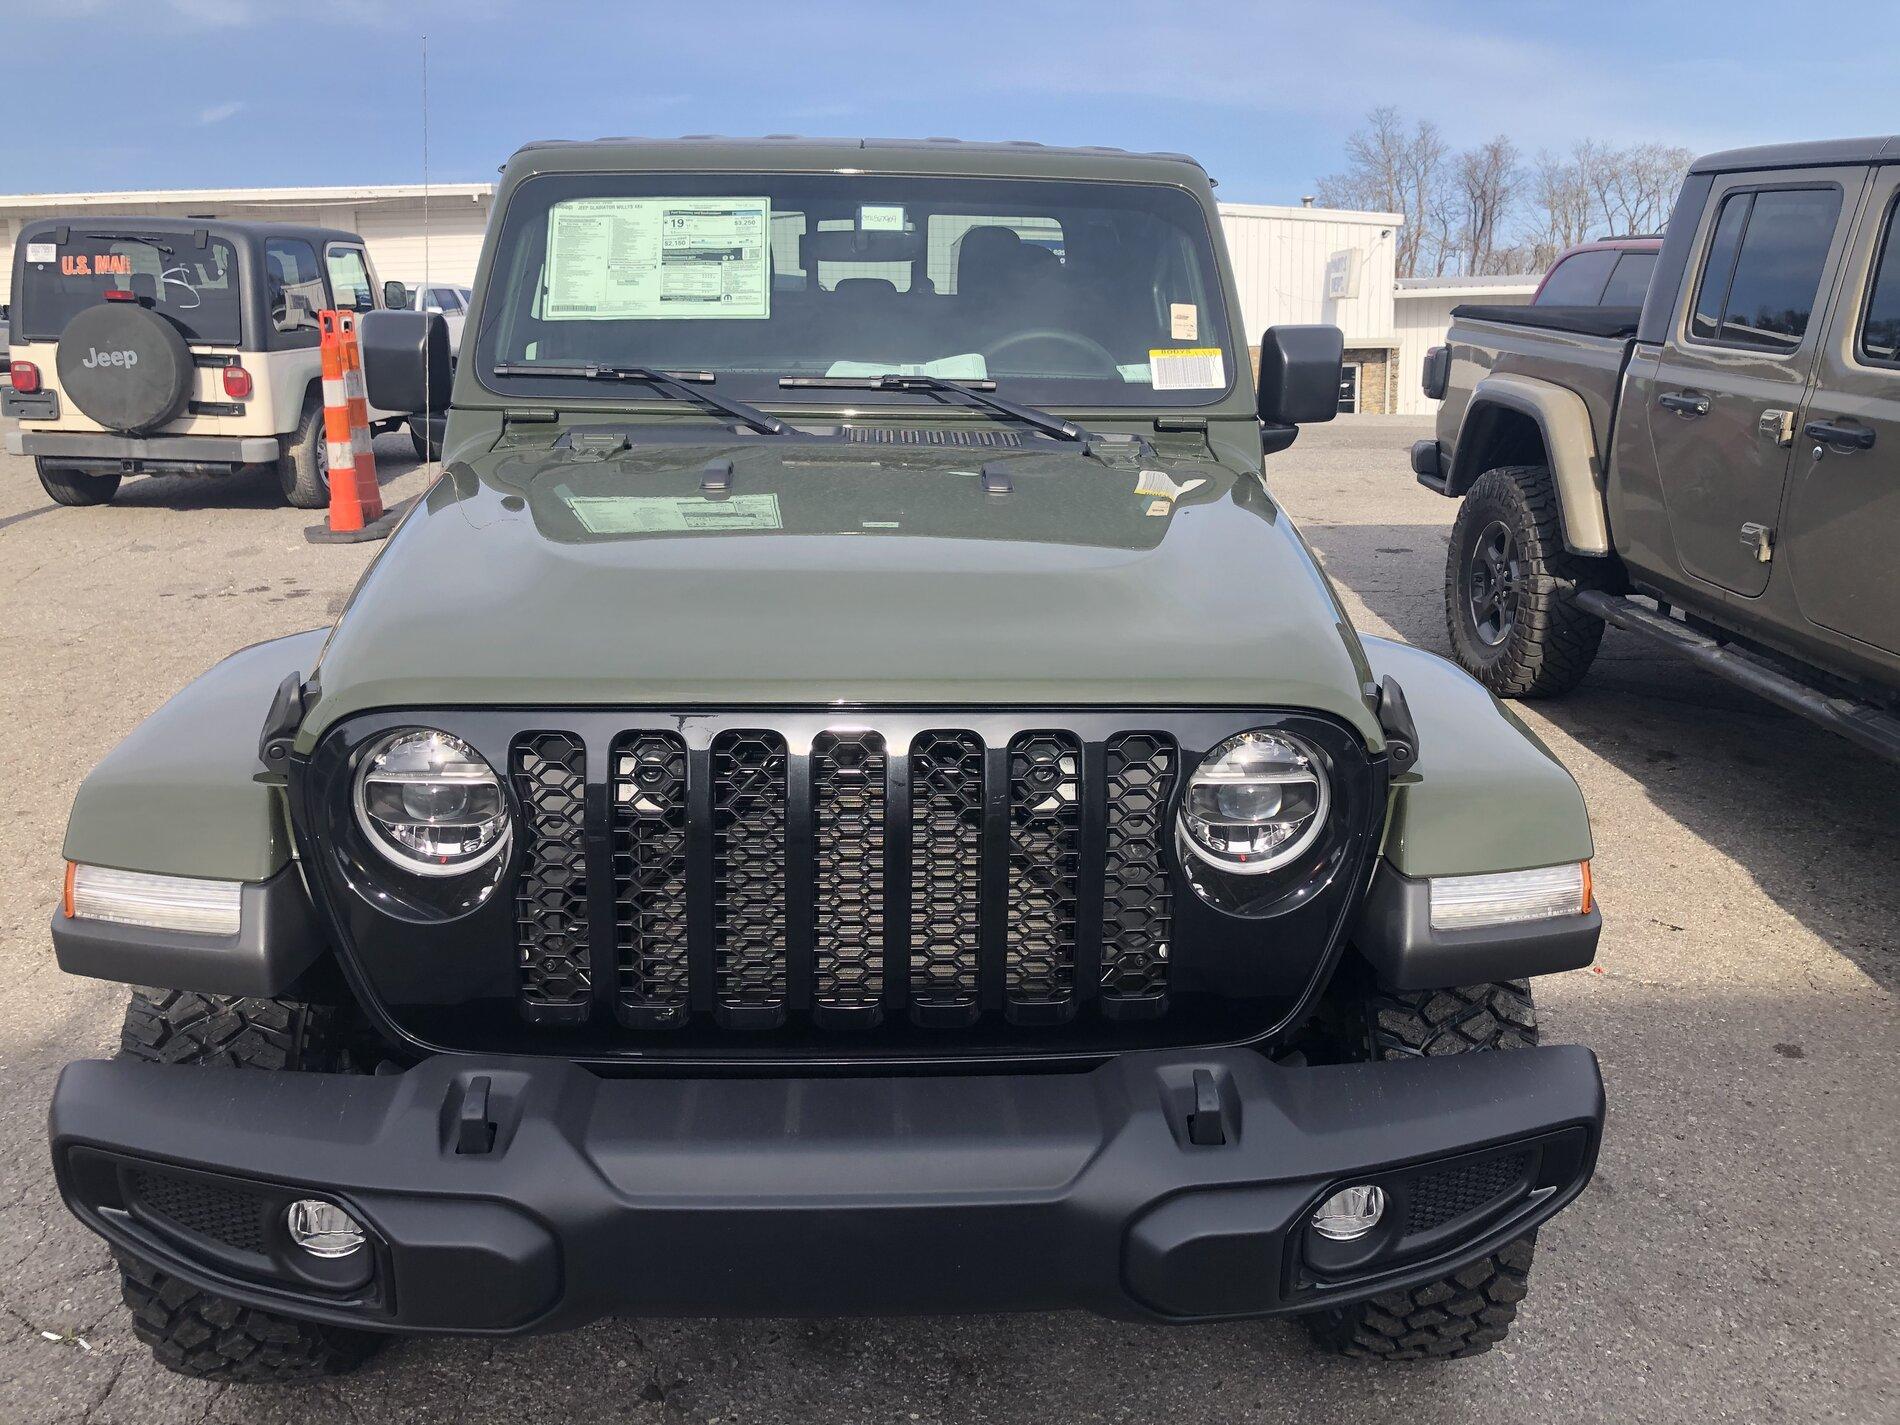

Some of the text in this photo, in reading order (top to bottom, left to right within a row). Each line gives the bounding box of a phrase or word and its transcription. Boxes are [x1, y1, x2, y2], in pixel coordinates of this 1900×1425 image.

[671, 218, 685, 228] 19
[62, 255, 92, 275] U.S.
[82, 347, 138, 369] Jeep
